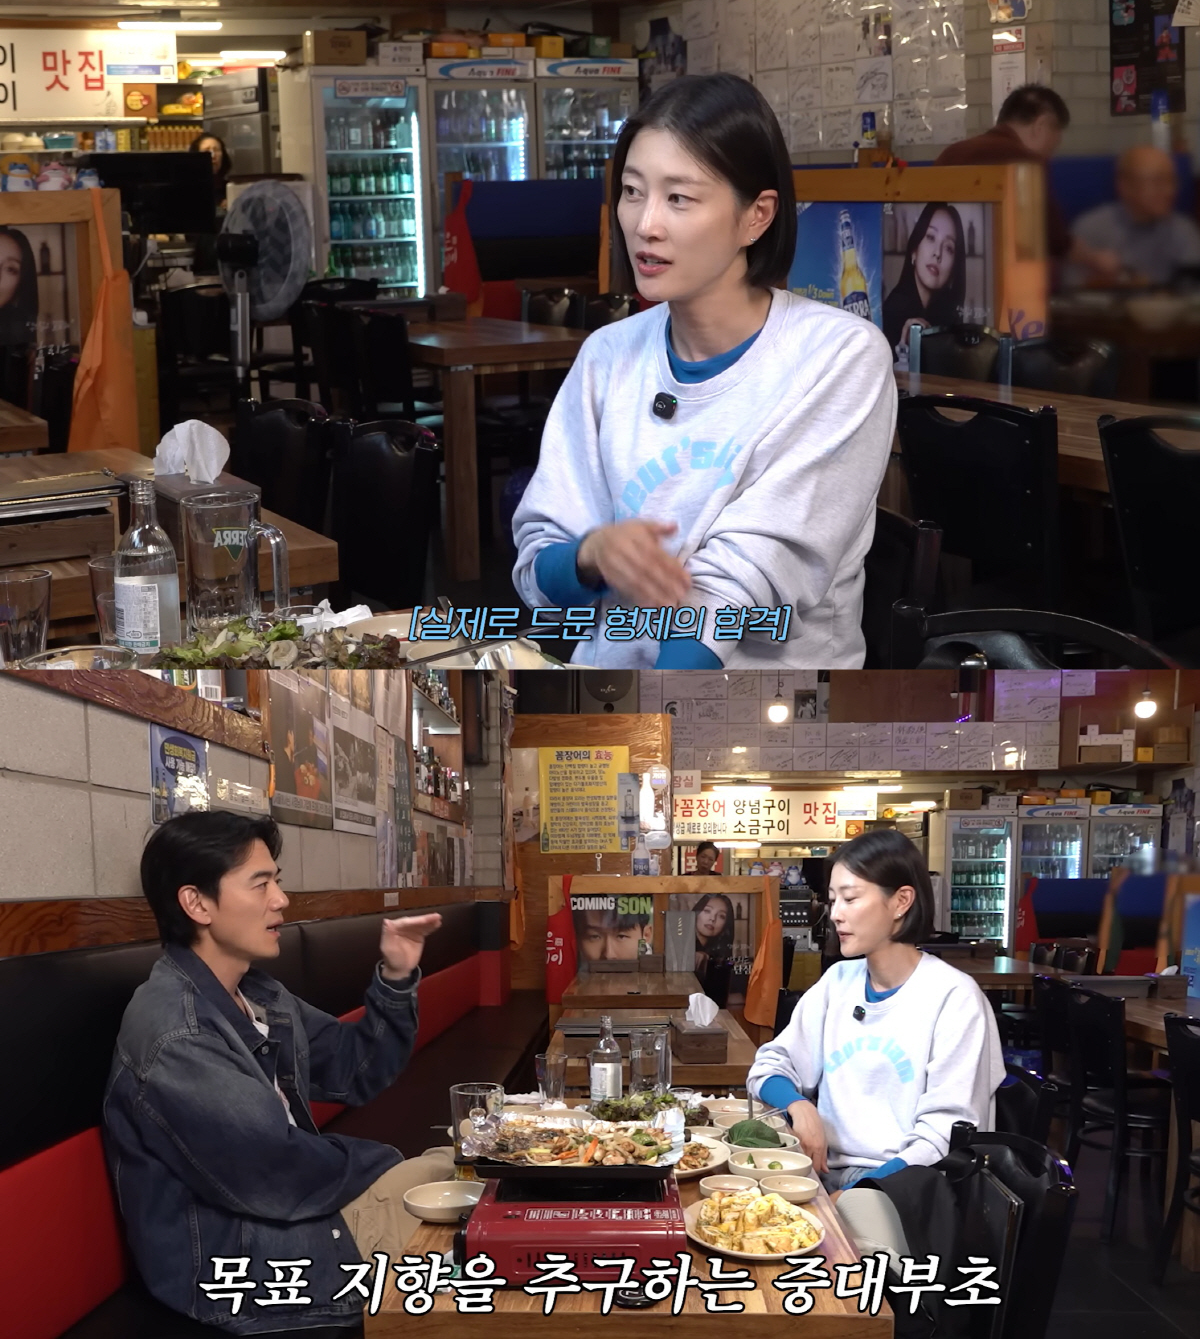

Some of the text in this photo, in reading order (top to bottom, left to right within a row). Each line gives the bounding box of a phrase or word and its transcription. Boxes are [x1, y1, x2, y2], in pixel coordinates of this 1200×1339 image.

[42, 50, 105, 92] 맛집
[555, 750, 614, 761] 꼼장어의 효능
[733, 798, 791, 815] 양념구이
[803, 801, 837, 825] 맛집
[733, 819, 790, 835] 소금구이
[571, 896, 652, 915] COMING SON
